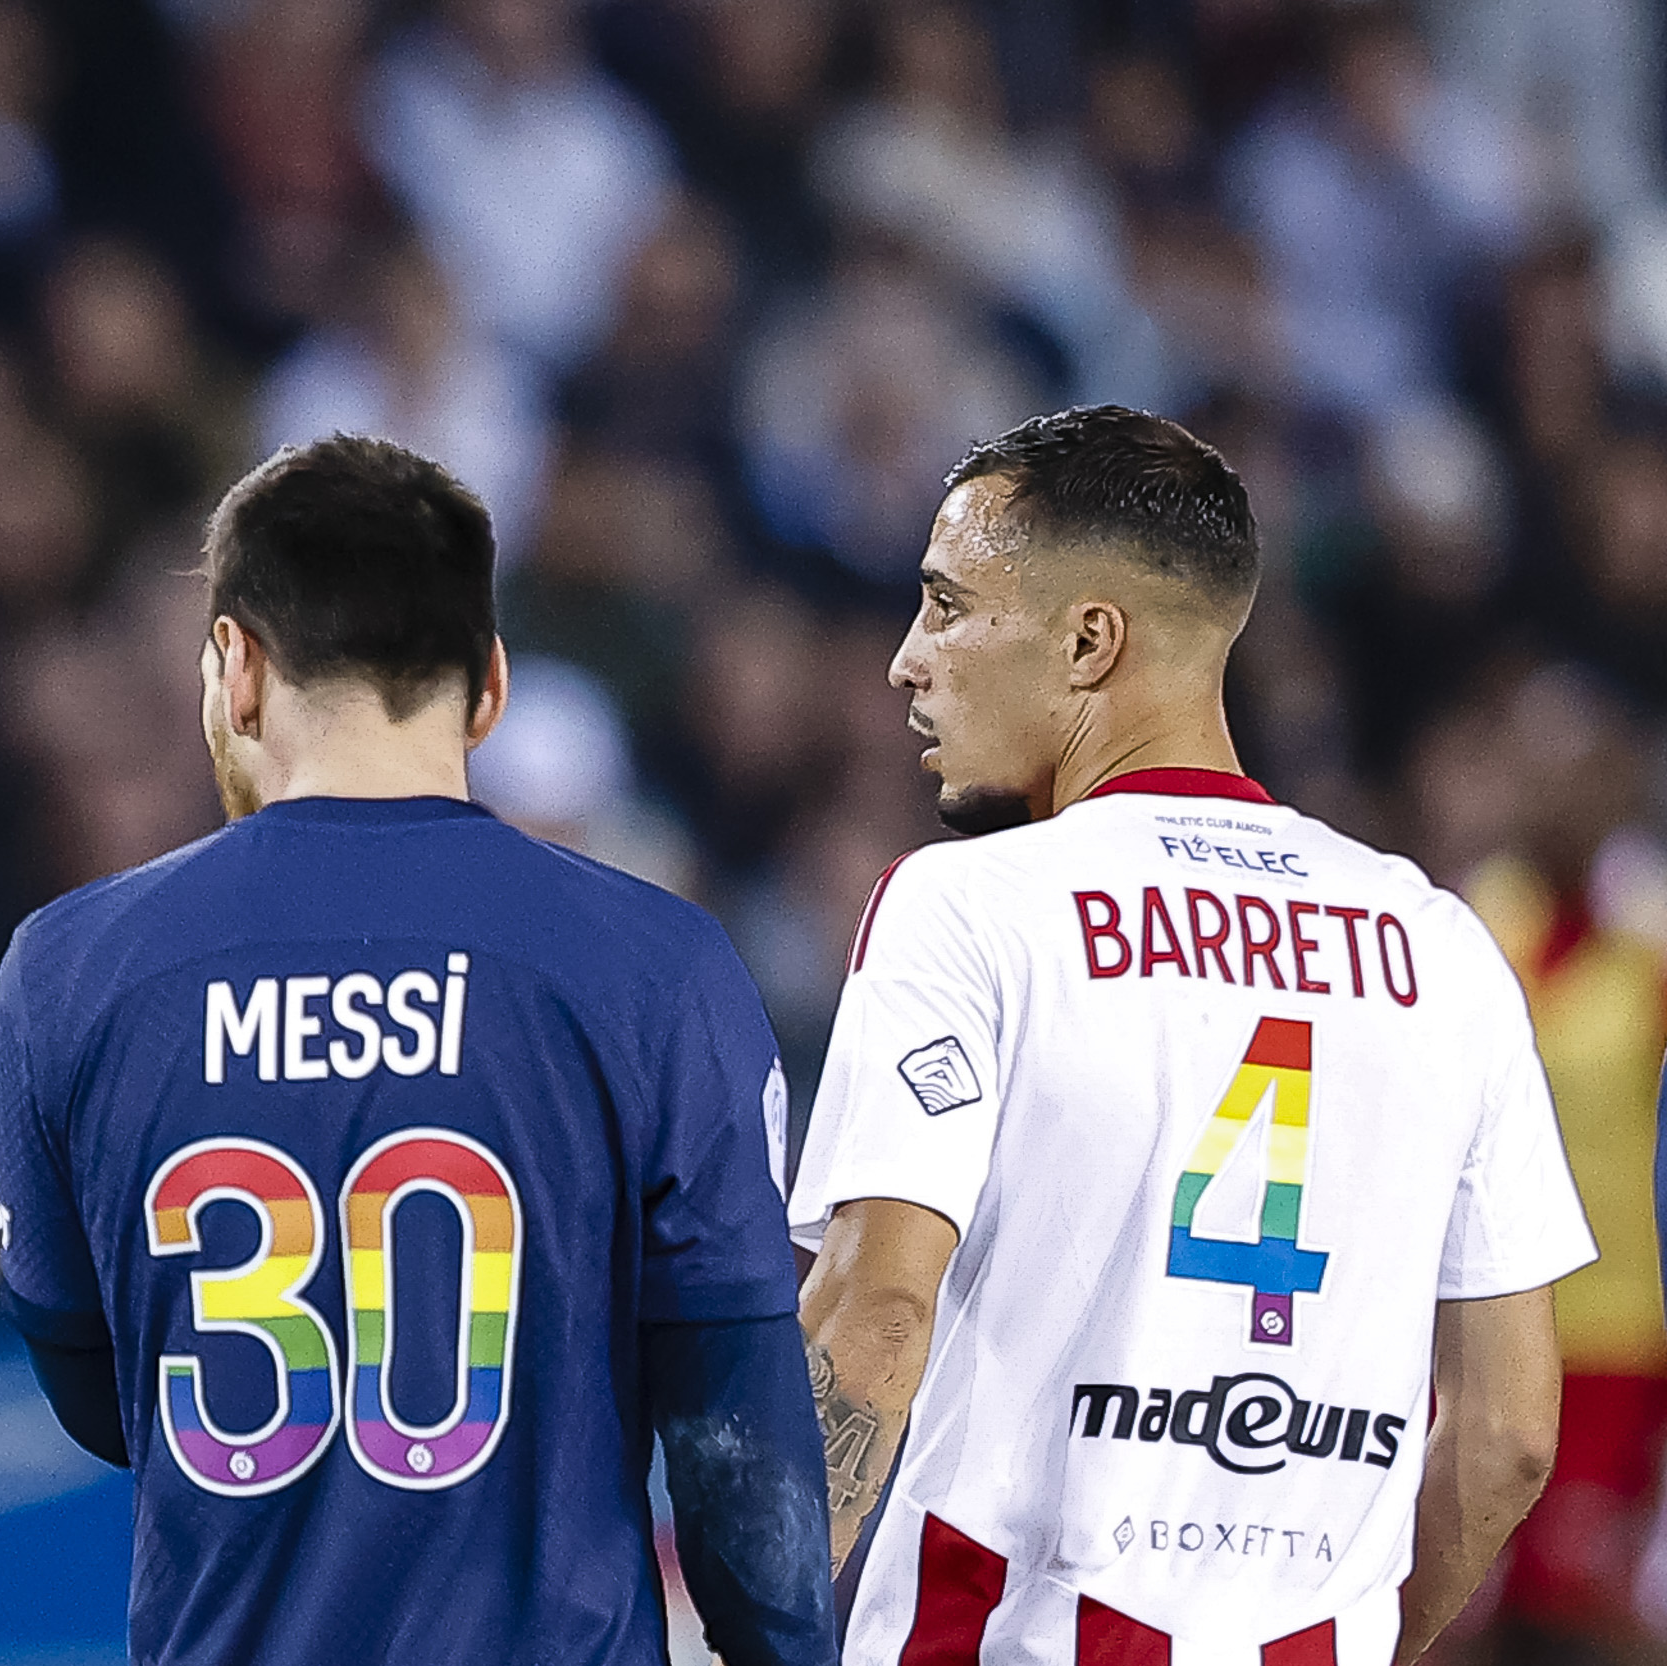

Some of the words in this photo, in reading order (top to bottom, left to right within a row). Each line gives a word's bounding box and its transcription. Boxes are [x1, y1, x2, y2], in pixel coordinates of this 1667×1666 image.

[1071, 886, 1418, 1008] BARRETO
[1164, 1016, 1331, 1347] 4
[144, 1126, 524, 1498] 30
[1150, 1519, 1333, 1563] BOXETTA
